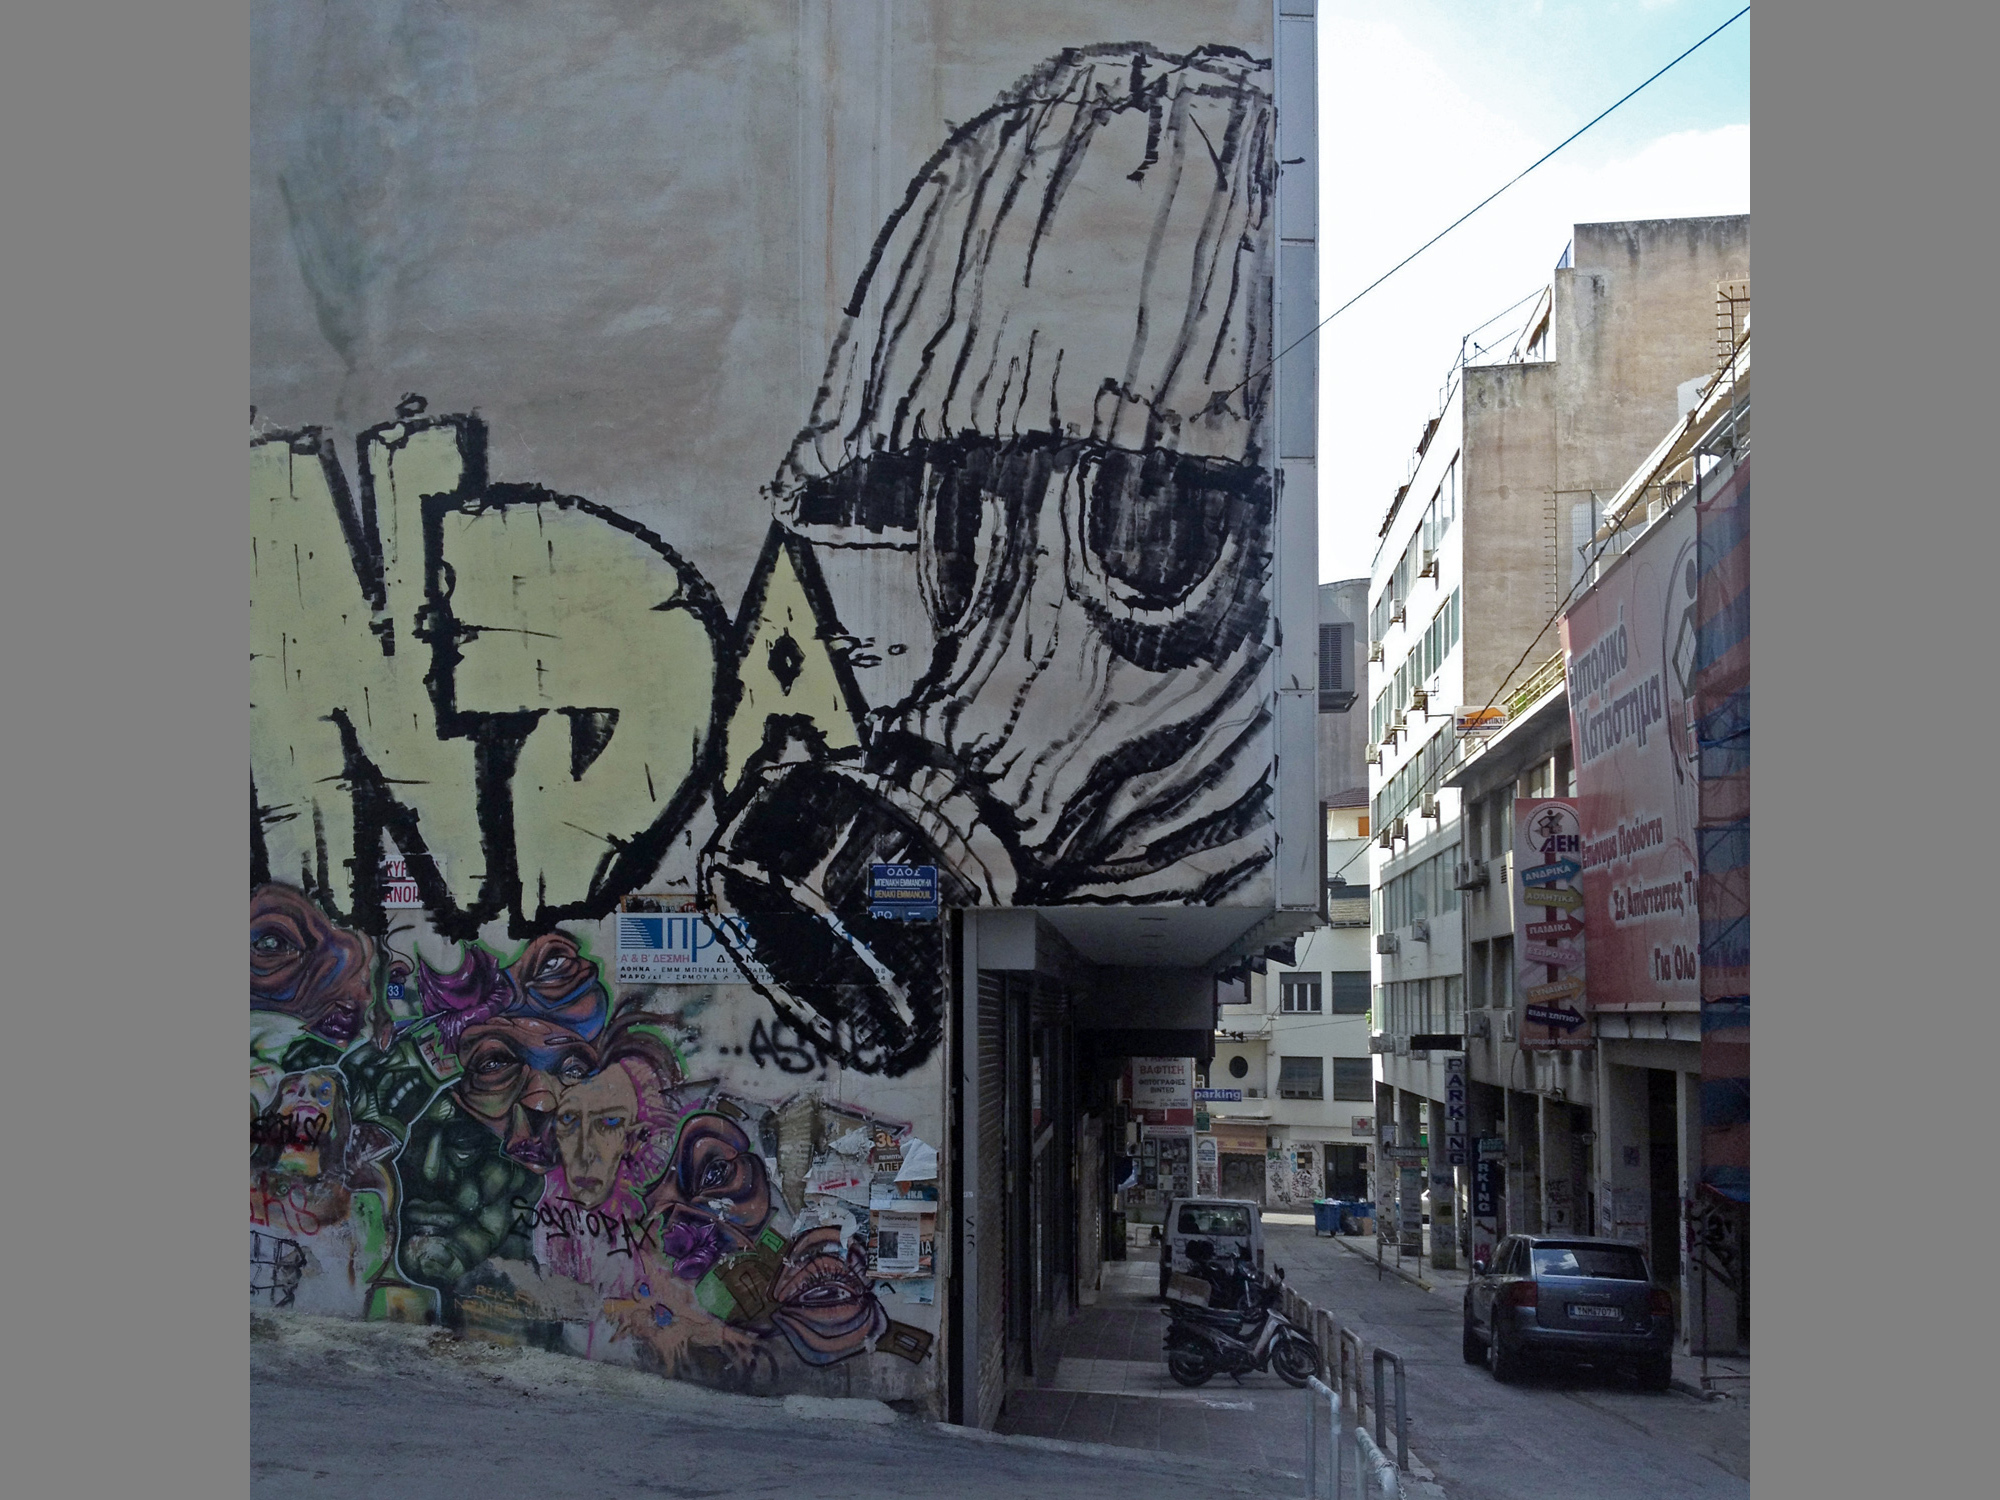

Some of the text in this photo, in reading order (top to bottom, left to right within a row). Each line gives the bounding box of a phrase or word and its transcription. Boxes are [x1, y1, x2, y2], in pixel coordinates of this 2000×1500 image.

[1567, 605, 1628, 719] Εμπορικό
[1579, 673, 1662, 764] Κατάστημα
[887, 868, 920, 876] ΟΔΟΣ
[1525, 865, 1571, 881] ΑΝΔΡΙΚΑ
[1613, 889, 1626, 921] Σε
[1529, 923, 1572, 934] ΠΑΙΔΙΚΑ
[653, 955, 690, 963] ΔΕΣΜΗ
[387, 985, 400, 996] 33
[1139, 1066, 1184, 1075] ΒΑΦΤΙΣΗ
[1194, 1089, 1241, 1100] parking
[1447, 1058, 1465, 1164] PARKING
